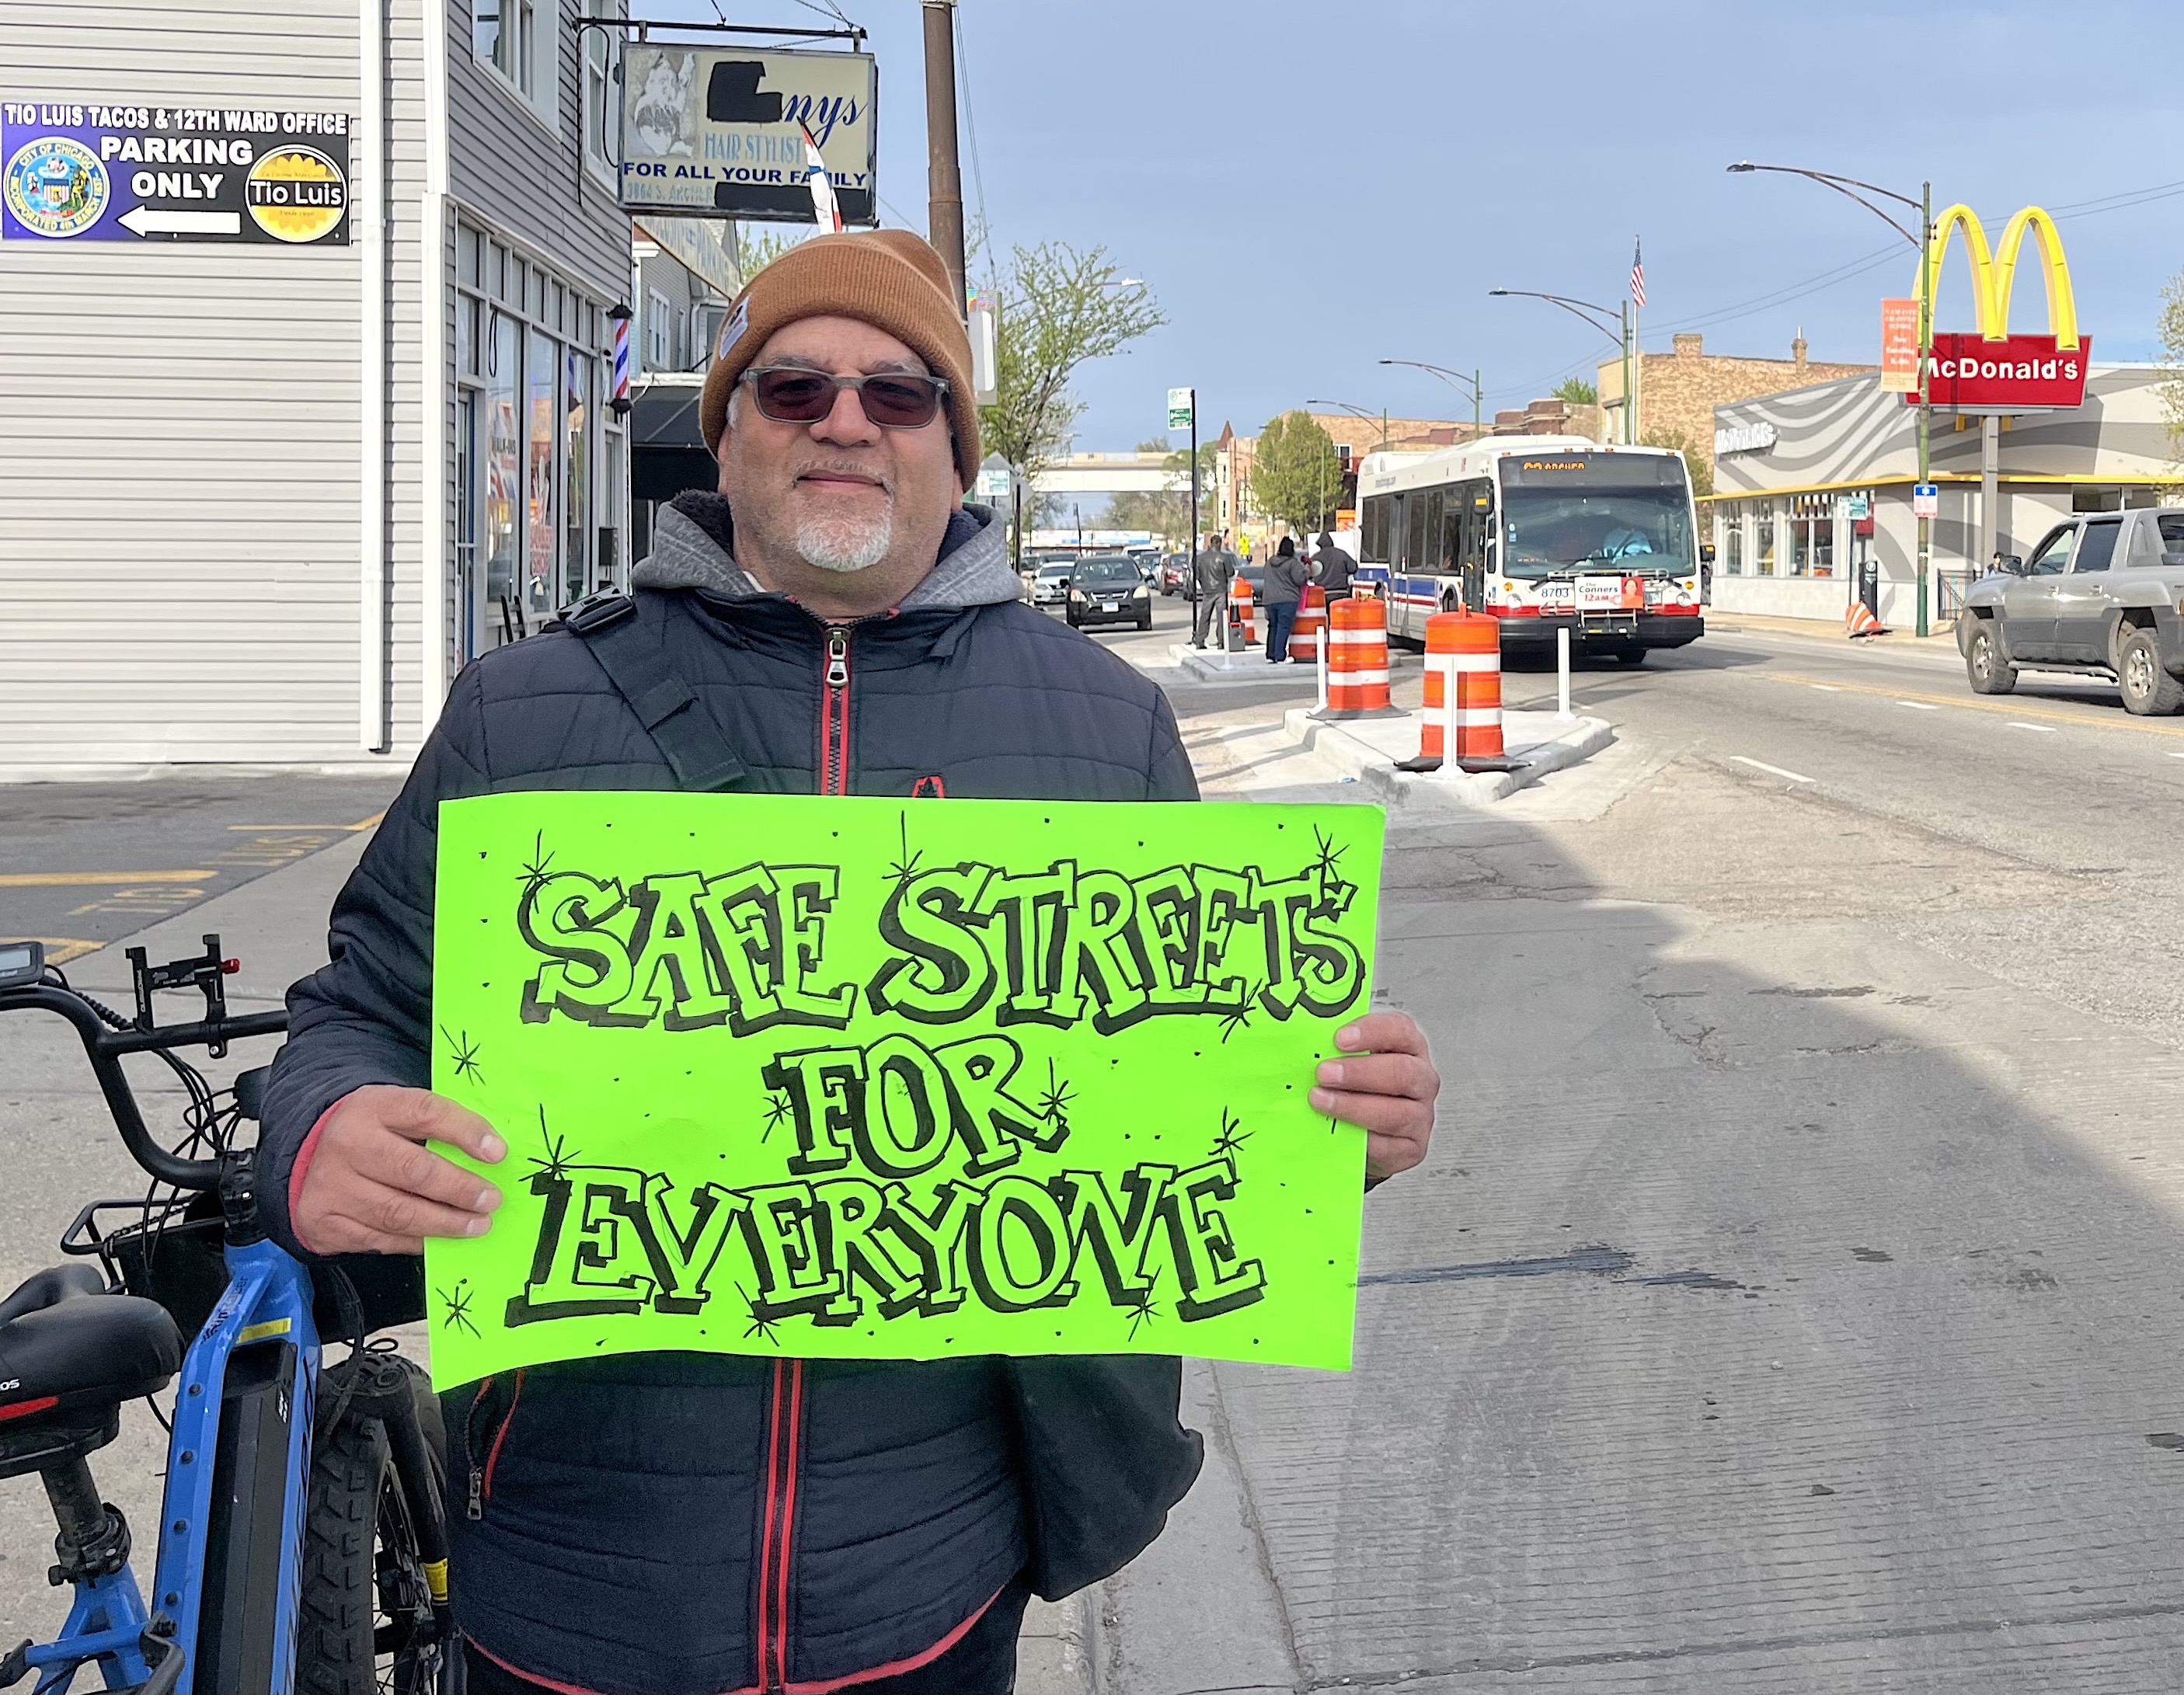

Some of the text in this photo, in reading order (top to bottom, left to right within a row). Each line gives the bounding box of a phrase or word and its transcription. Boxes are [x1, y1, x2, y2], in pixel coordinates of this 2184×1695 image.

[5, 104, 347, 134] TIO LUIS TACOS & 12TH WARD OFFICE
[19, 144, 95, 169] CITY OF CHICAGO
[100, 136, 253, 165] PARKING
[705, 132, 803, 164] HAIR STYLIST
[131, 172, 224, 200] ONLY
[623, 162, 867, 186] FOR ALL YOUR FAILY
[250, 181, 342, 205] Tio Luis
[1541, 587, 1569, 598] 8703
[518, 858, 1365, 1037] SAFE STREETS
[761, 1033, 1069, 1178] FOR
[504, 1157, 1265, 1327] EVERYONE
